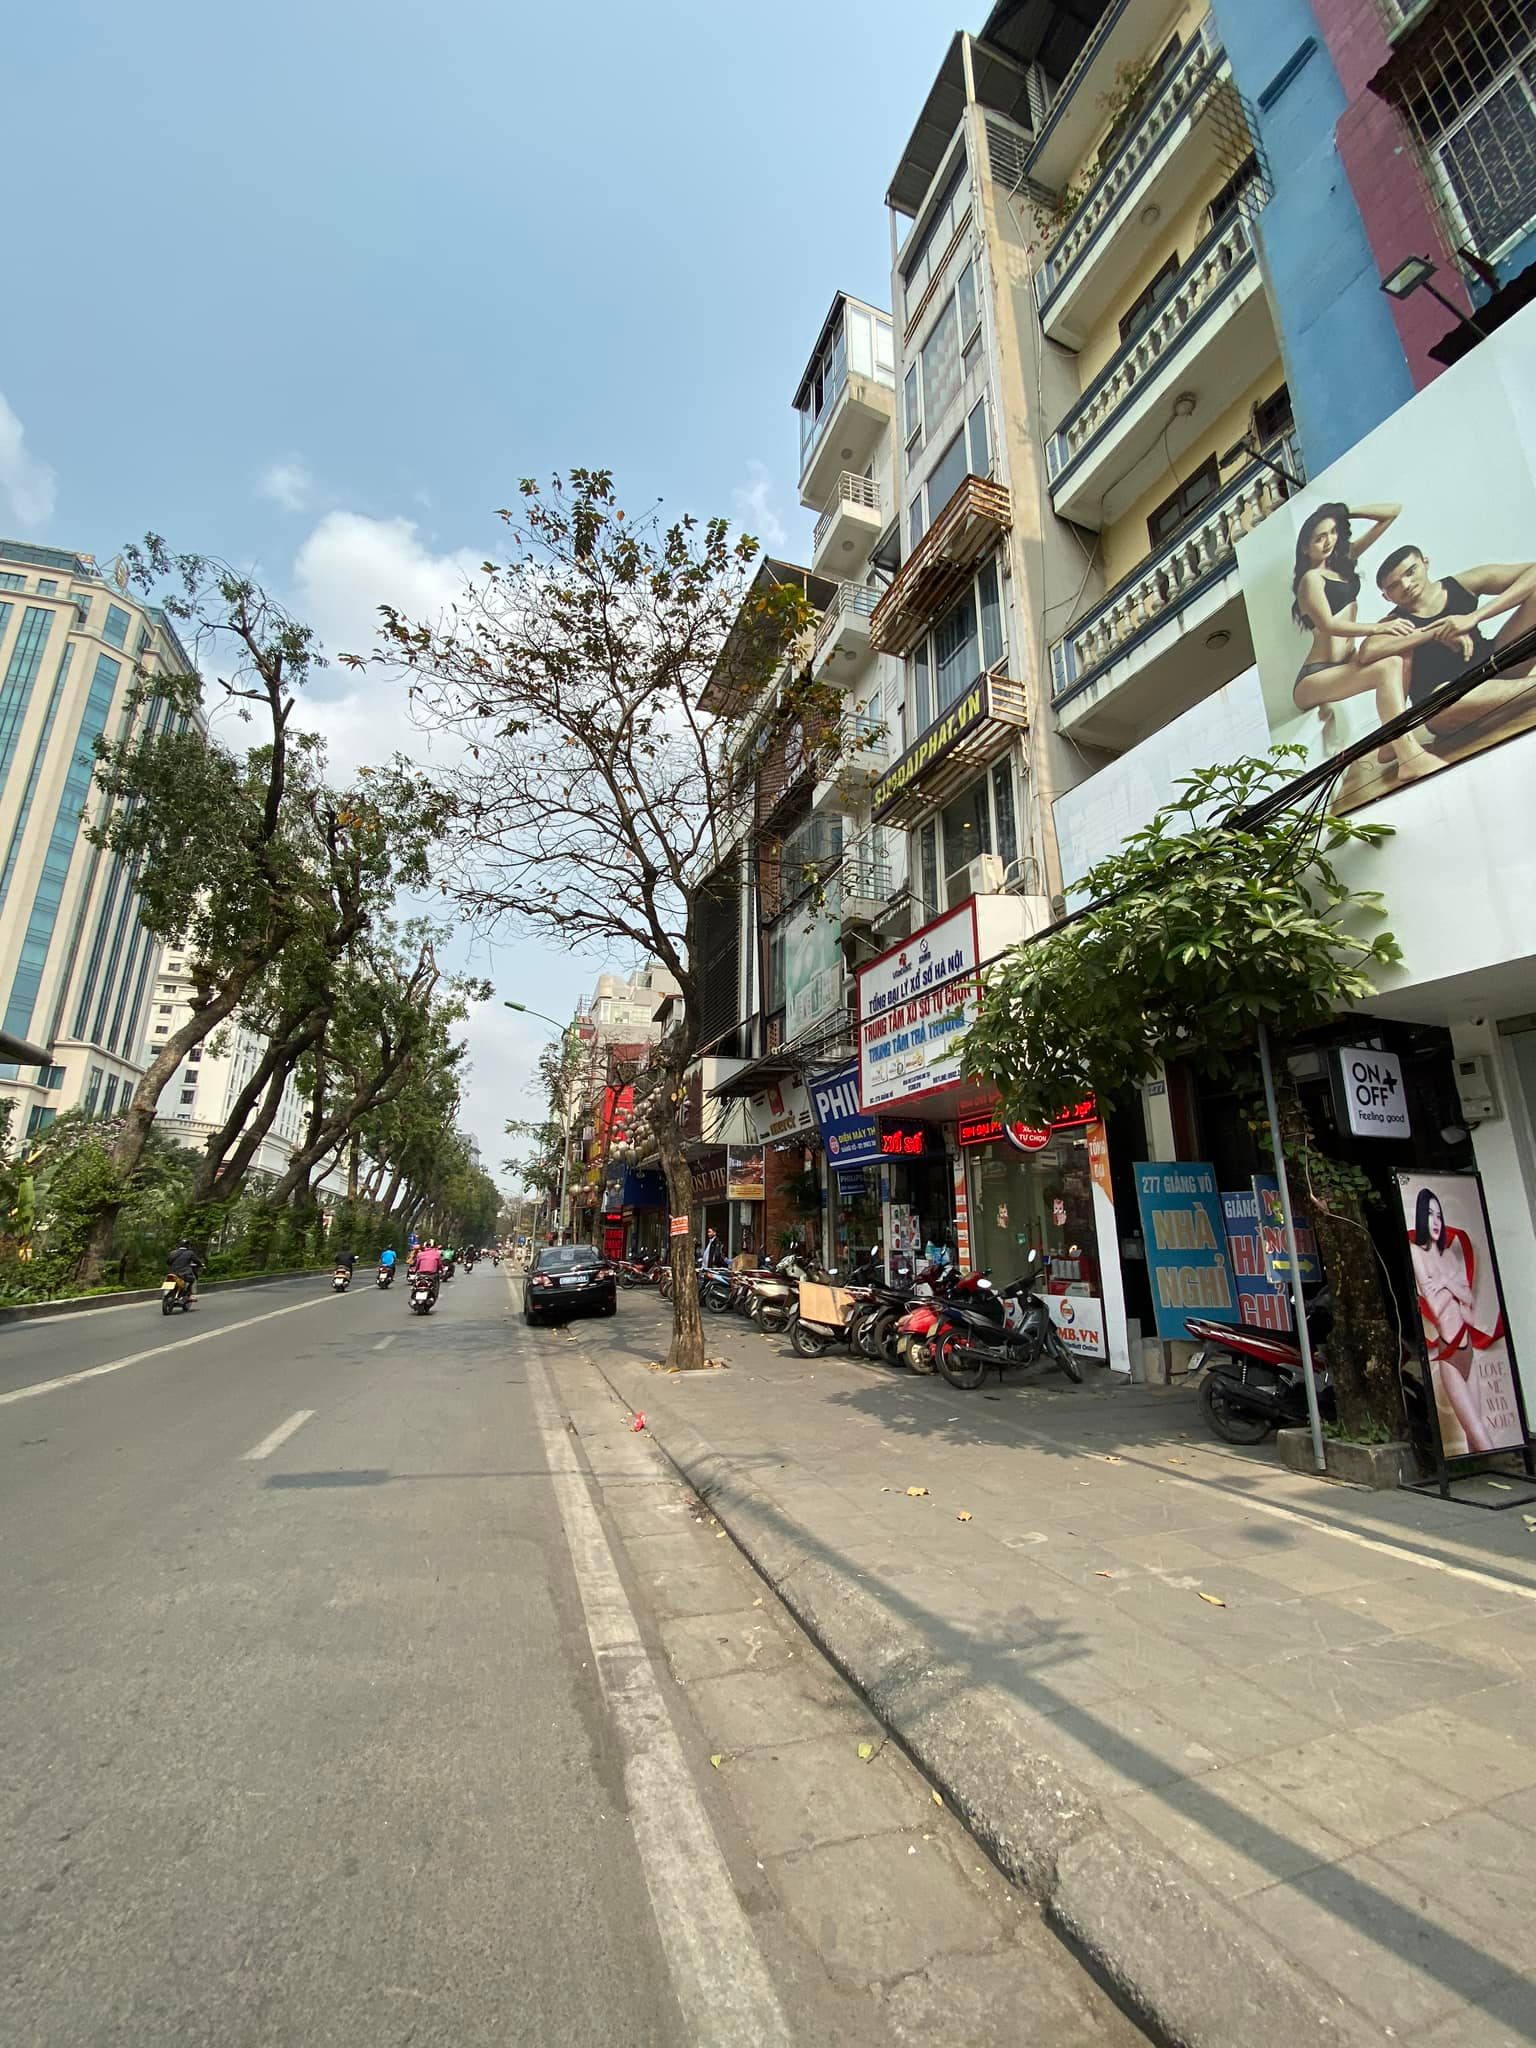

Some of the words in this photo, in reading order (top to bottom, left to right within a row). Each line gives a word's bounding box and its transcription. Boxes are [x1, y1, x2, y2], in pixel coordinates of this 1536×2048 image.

[868, 992, 886, 1014] TỔNG
[887, 985, 899, 1004] ĐẠI
[900, 976, 909, 998] LÝ
[910, 968, 920, 992] XỔ
[922, 961, 933, 986] SỐ
[935, 958, 947, 980] HÀ
[947, 949, 964, 973] NỘI
[864, 1017, 887, 1044] TRUNG
[868, 1042, 892, 1064] TRUNG
[892, 1034, 909, 1056] TÂM
[911, 1021, 927, 1046] TRẢ
[1352, 1062, 1380, 1084] ON
[1356, 1084, 1389, 1106] OFF
[1358, 1110, 1384, 1123] Feeling
[1386, 1113, 1405, 1123] good
[1029, 1134, 1047, 1142] CHỌN
[1142, 1176, 1160, 1193] 277
[1163, 1170, 1197, 1194] GIẢNG
[1197, 1171, 1213, 1193] VÕ
[1224, 1193, 1260, 1218] GIẢNG
[1151, 1201, 1218, 1250] NHÀ
[1228, 1225, 1266, 1277] HÀ
[1156, 1254, 1233, 1309] NGHỈ
